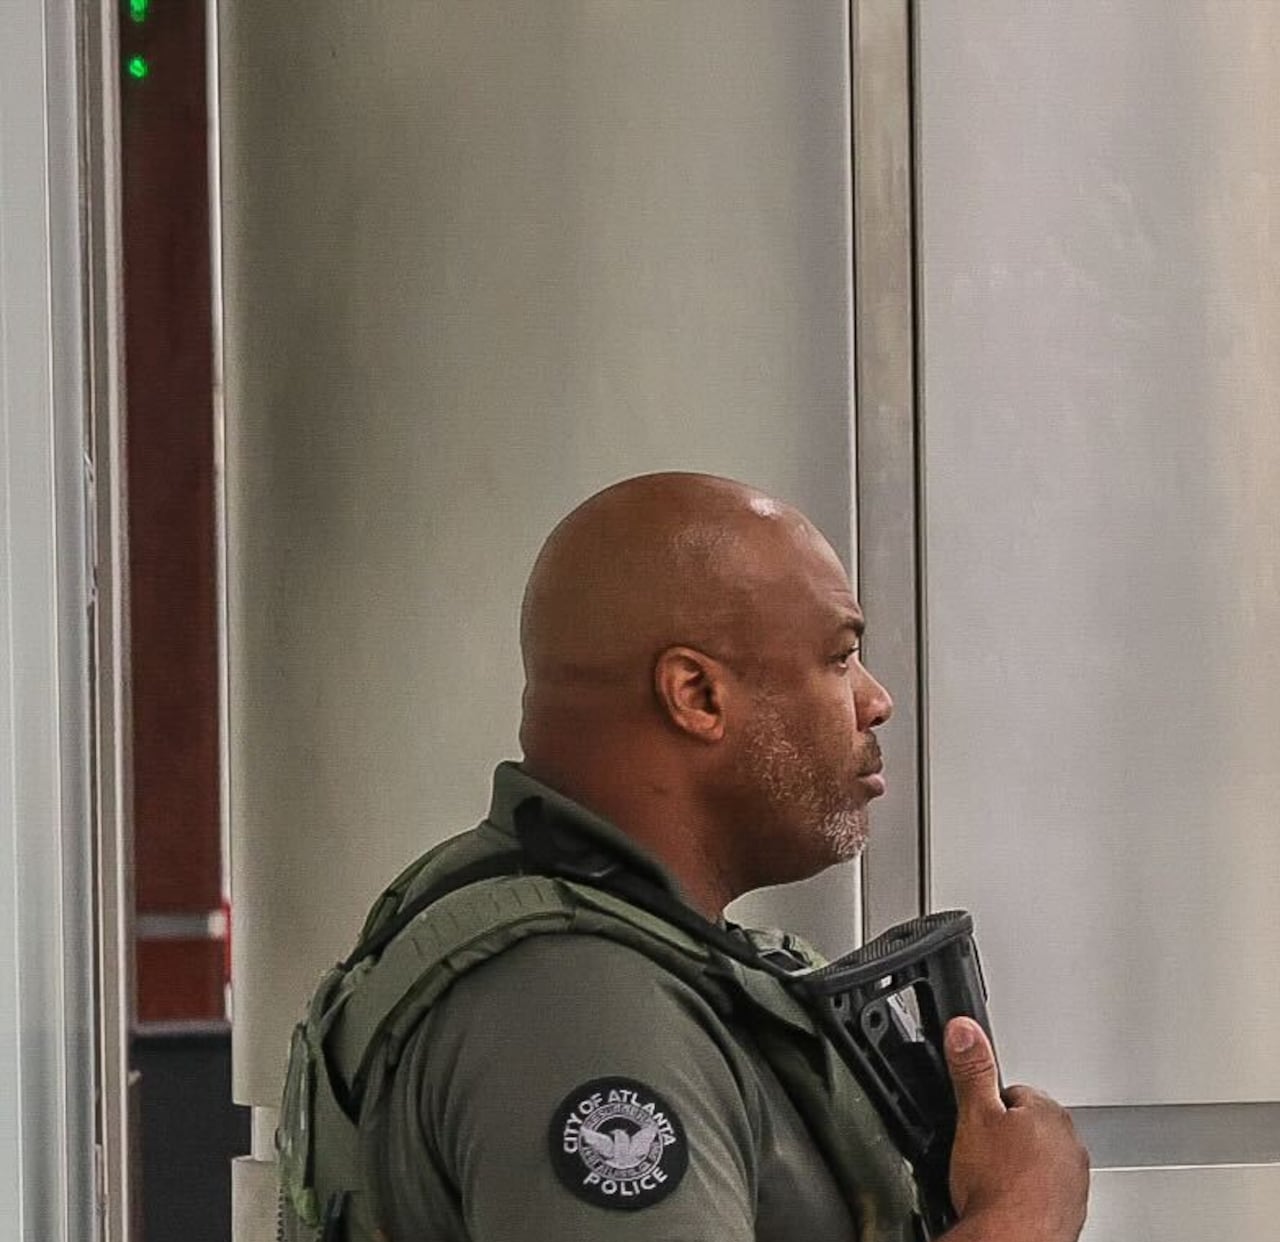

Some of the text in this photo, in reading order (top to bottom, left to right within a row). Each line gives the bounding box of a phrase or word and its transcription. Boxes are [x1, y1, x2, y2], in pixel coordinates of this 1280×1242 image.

[563, 1112, 583, 1153] CITY
[579, 1092, 603, 1114] OF
[607, 1089, 676, 1146] ATLANTA
[583, 1166, 668, 1196] POLICE
